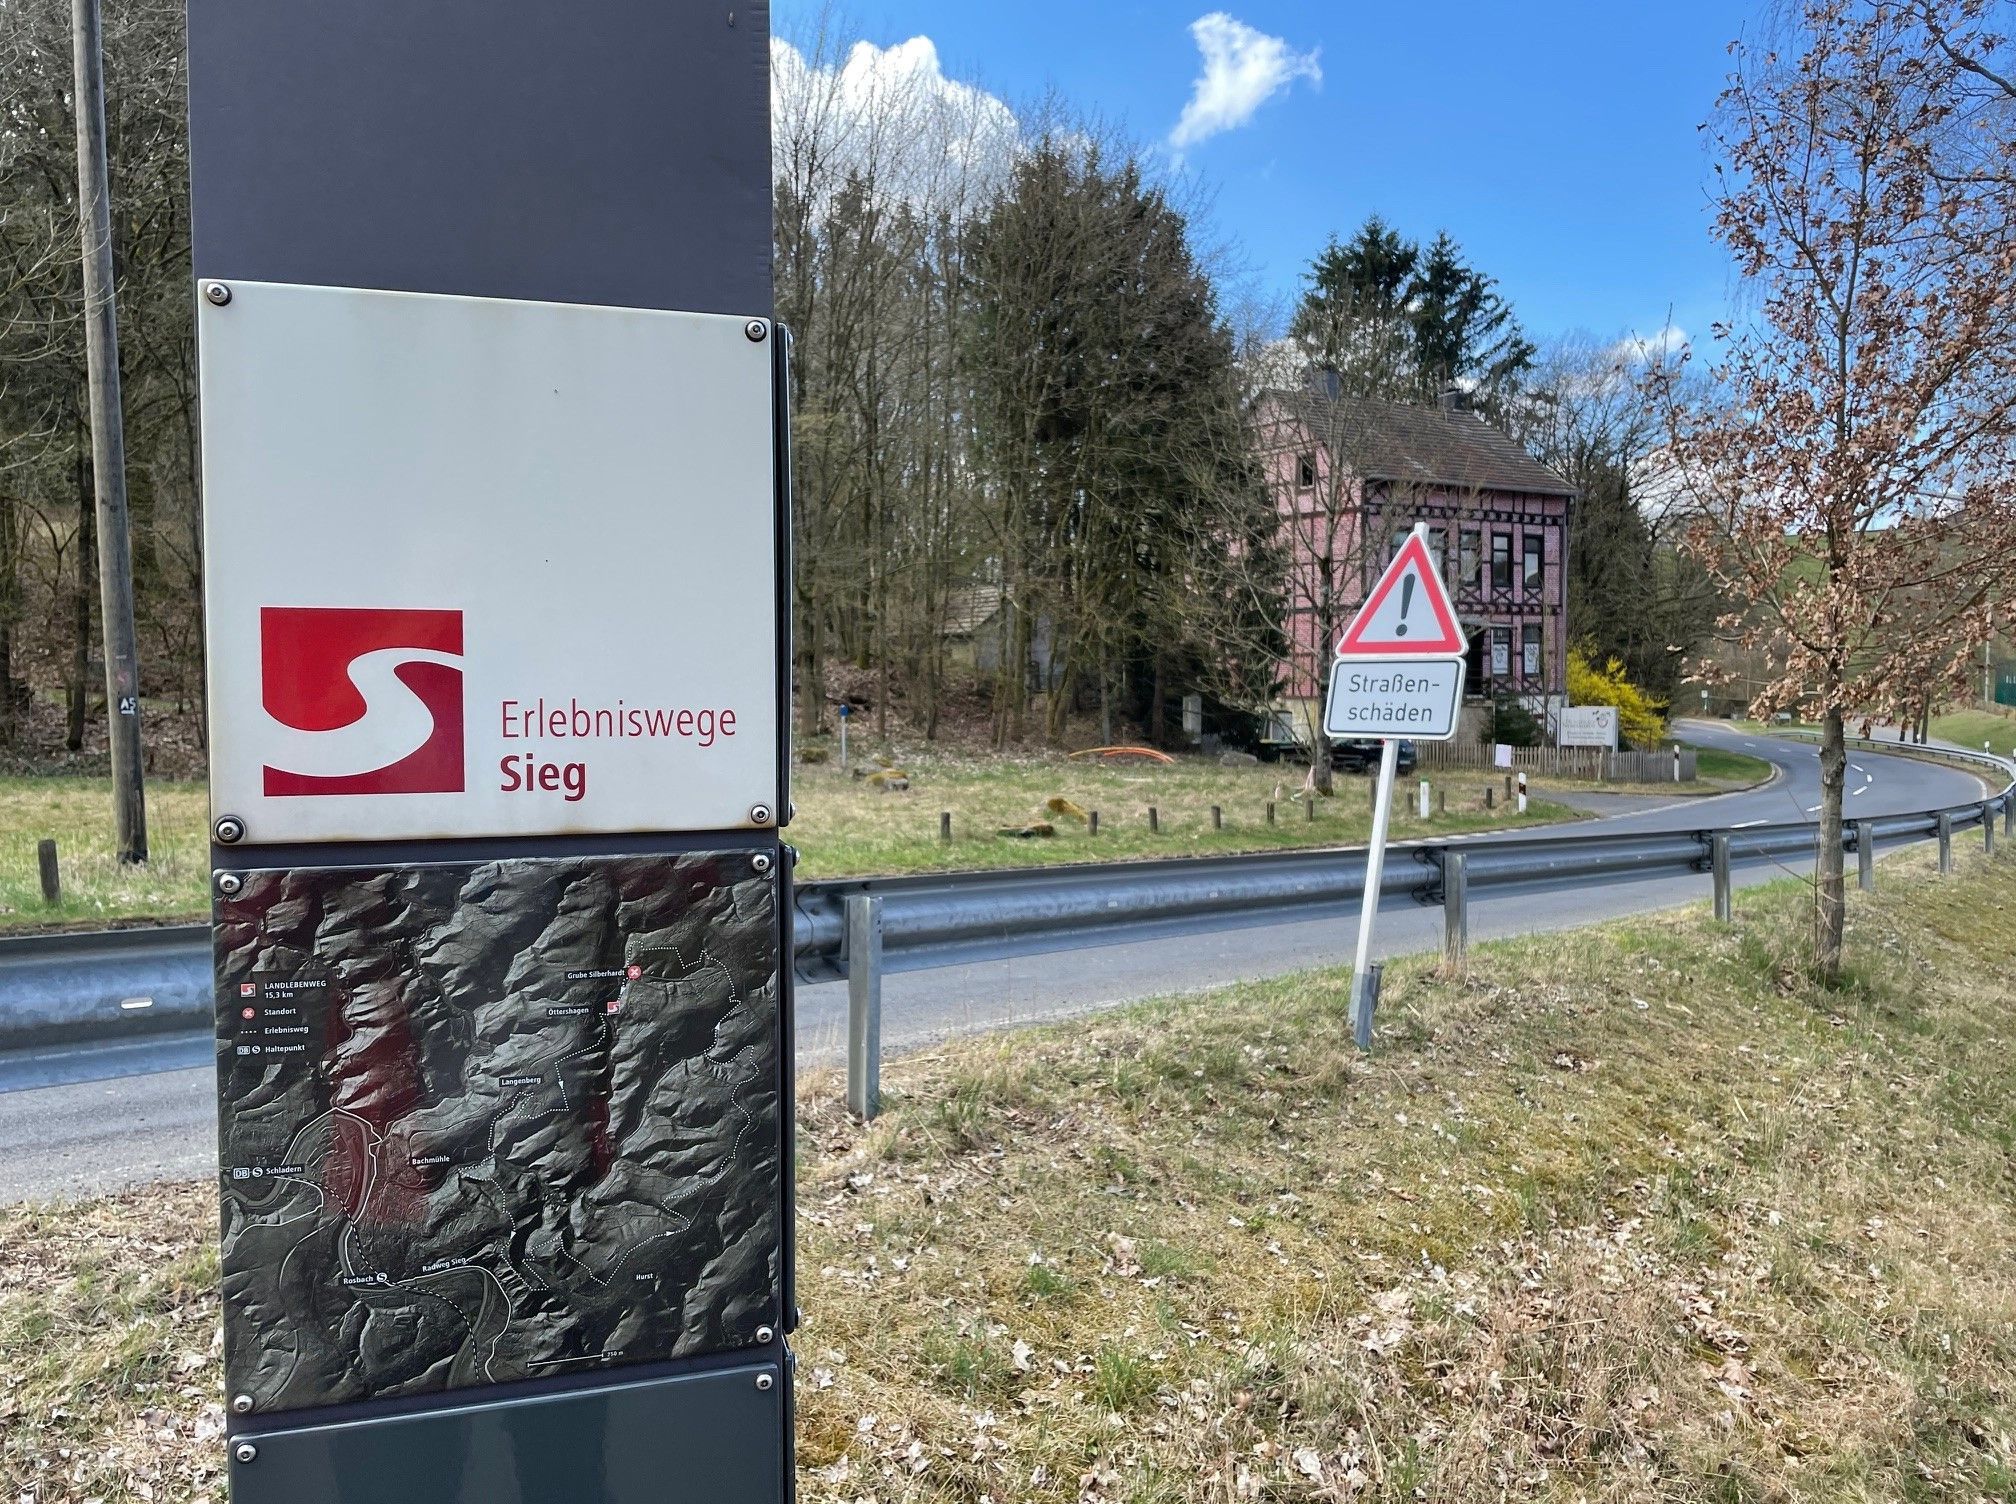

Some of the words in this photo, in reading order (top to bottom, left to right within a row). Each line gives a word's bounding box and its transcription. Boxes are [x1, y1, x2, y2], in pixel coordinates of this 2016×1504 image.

[1348, 674, 1440, 693] Straßen-
[1347, 702, 1433, 722] schäden
[502, 698, 736, 746] Erlebniswege
[500, 753, 586, 801] Sieg
[567, 971, 587, 980] Grube
[588, 970, 625, 979] Silberhardt
[264, 980, 327, 990] LANDLEBENWEG
[264, 991, 280, 999] 15,3
[264, 1007, 296, 1016] Standort
[264, 1026, 309, 1035] Erlebnisweg
[265, 1044, 305, 1054] Haltepunkt
[501, 1076, 541, 1086] Langenberg
[412, 1155, 450, 1165] Bachmühle
[266, 1166, 302, 1175] Schladern
[422, 1262, 450, 1272] Radweg
[343, 1275, 373, 1285] Rosbach
[636, 1272, 653, 1281] Hurst
